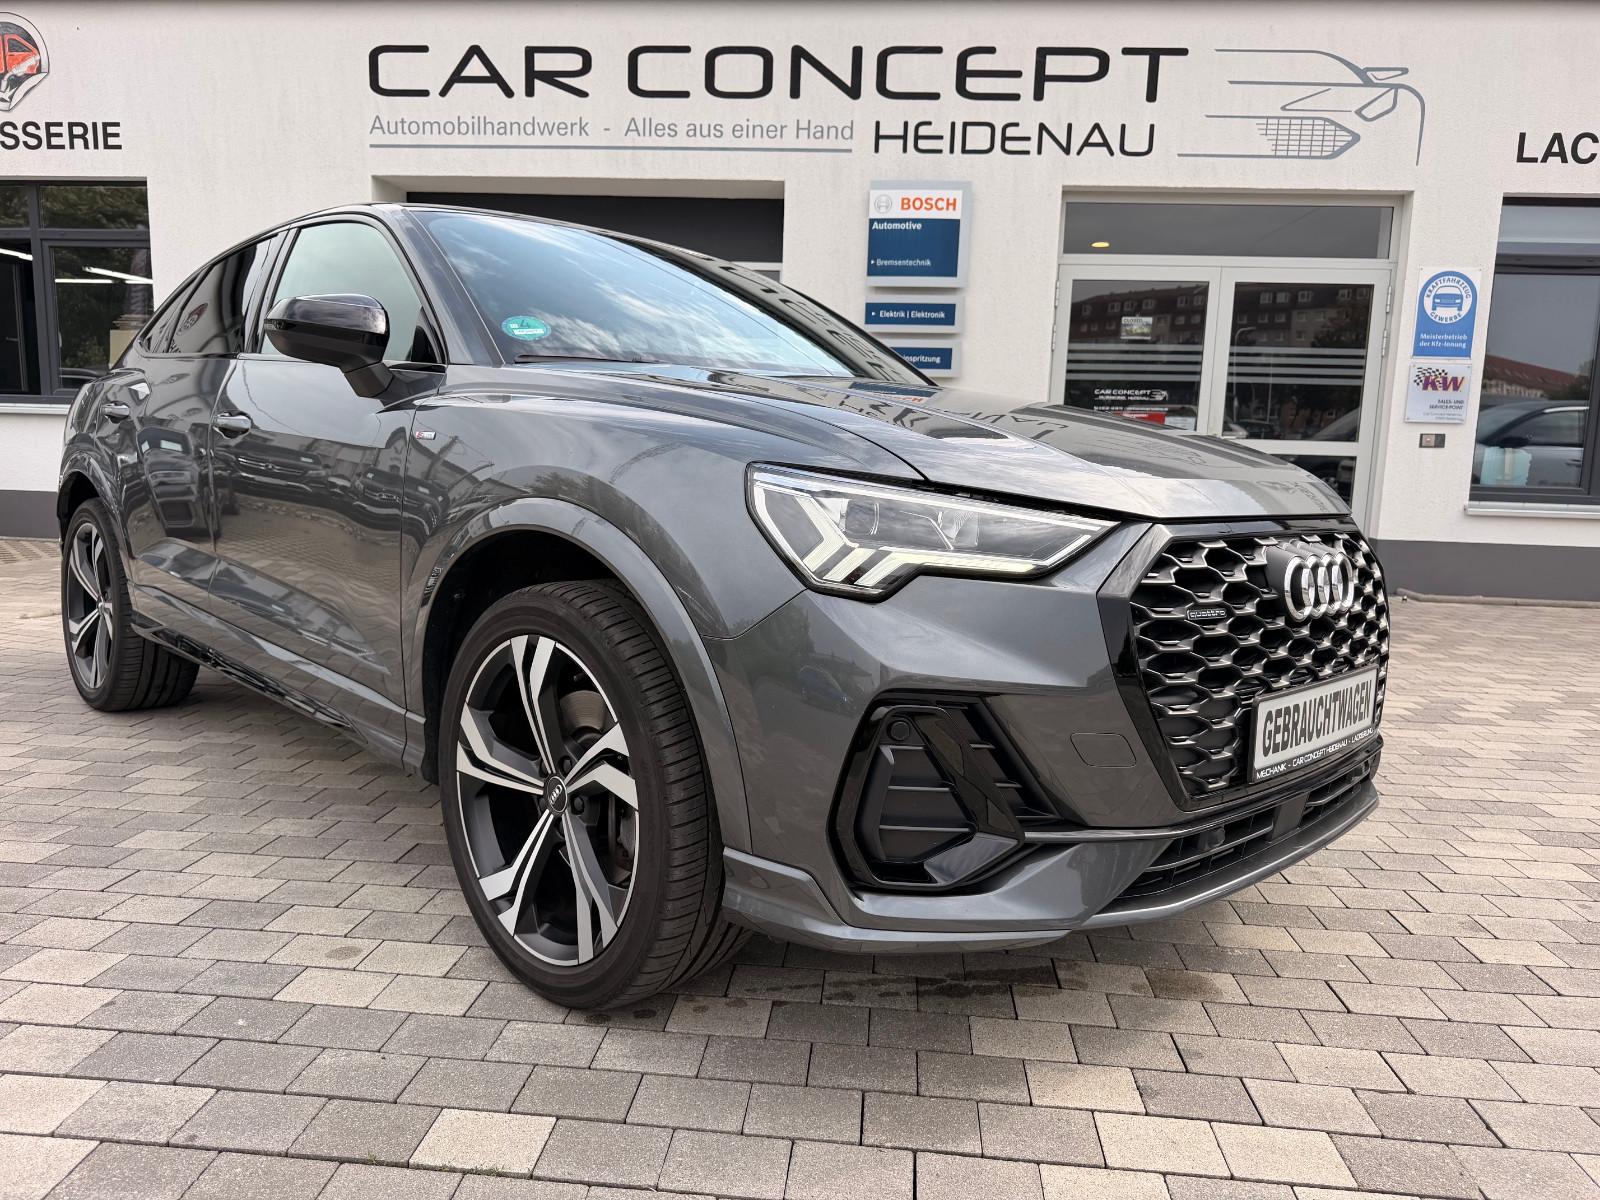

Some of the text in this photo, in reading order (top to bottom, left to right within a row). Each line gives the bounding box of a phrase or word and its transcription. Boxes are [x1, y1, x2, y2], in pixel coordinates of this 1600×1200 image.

[368, 44, 1188, 103] CAR CONCEPT
[0, 121, 123, 150] SSERIE
[369, 115, 589, 136] Automobilhandwerk
[624, 117, 678, 138] Alles
[686, 123, 724, 139] aus
[731, 119, 787, 139] einer
[796, 119, 854, 140] Hand
[874, 120, 1155, 157] HEIDENAU
[1516, 132, 1600, 165] LAC
[901, 197, 957, 211] BOSCH
[872, 221, 922, 230] Automotive
[876, 258, 931, 266] Bremsentechnik
[1426, 277, 1471, 299] KRAFTFAHRZEUG
[880, 310, 906, 318] Elektrik
[911, 310, 945, 319] Elektronik
[1430, 311, 1462, 322] GEWERBE
[1262, 679, 1372, 758] GEBRAUCHTWAGEN
